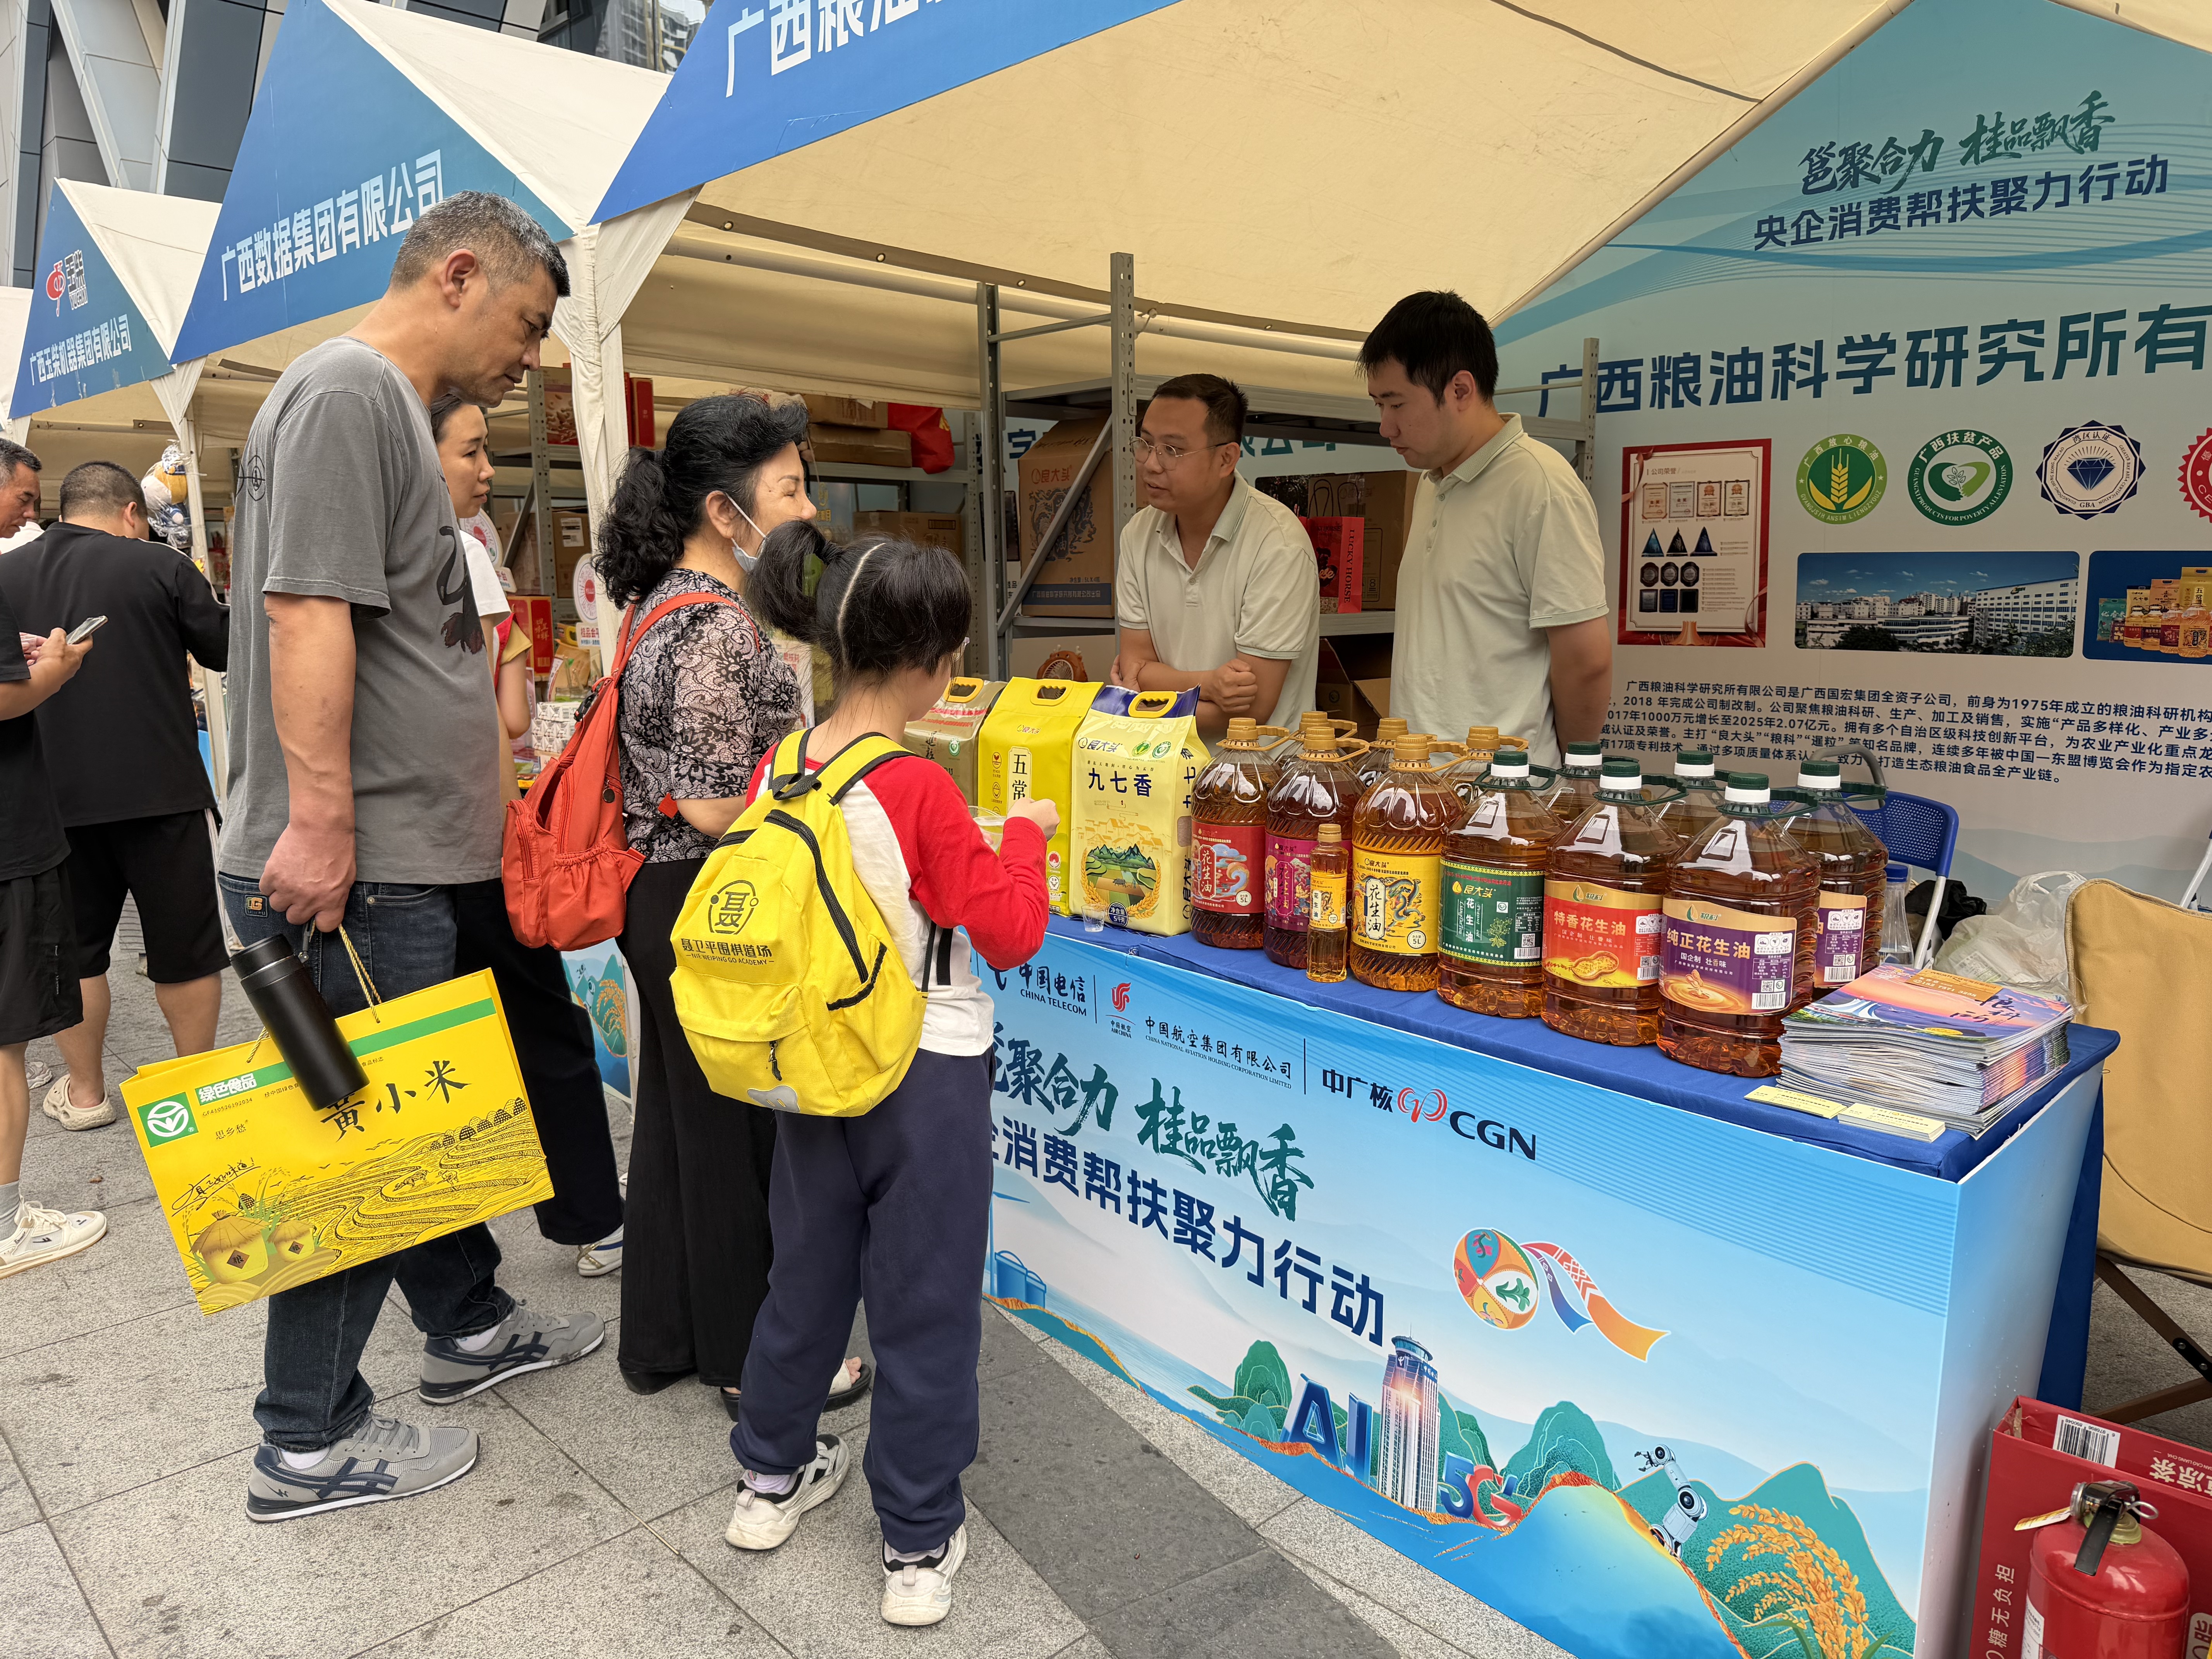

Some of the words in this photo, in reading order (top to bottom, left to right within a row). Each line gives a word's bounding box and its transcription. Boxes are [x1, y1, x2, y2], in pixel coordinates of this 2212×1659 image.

[726, 0, 945, 98] 广西粮
[1959, 89, 2116, 166] 桂品飘香
[1754, 154, 2169, 251] 央企消费帮扶聚力行动
[221, 149, 443, 301] 广西数据集团有限公司
[30, 314, 132, 385] 广西玉柴机器集团有限公司
[1537, 303, 2212, 417] 广西粮油科学研究所有
[1805, 436, 1879, 467] 广西放心粮油
[1918, 431, 2004, 463] 广西扶贫产品
[2072, 431, 2112, 443] 湾区认证
[1041, 467, 1070, 483] 良大头
[1913, 468, 1923, 498] GUANGXI
[1989, 464, 2007, 510] ALLEVIATION
[1917, 496, 1945, 520] PRODUCTS
[1960, 508, 1990, 521] POVERTY
[1346, 529, 1355, 565] LUCKY
[1344, 567, 1352, 603] HORSE
[1087, 740, 1120, 752] 良大头
[1088, 768, 1152, 797] 九七香
[1202, 850, 1212, 893] 花生油
[1464, 885, 1492, 898] 良大头
[1110, 905, 1125, 915] 净含量
[1113, 915, 1126, 924] 5千克
[1368, 884, 1382, 932] 花生油
[1465, 897, 1475, 943] 花生油
[1554, 910, 1626, 936] 特香花生油
[680, 938, 772, 958] 聂卫平围棋道场
[1562, 929, 1582, 938] 国企制
[1589, 935, 1613, 943] 壮香味
[1667, 927, 1751, 960] 纯正花生油
[702, 955, 726, 963] WEIPING
[1680, 952, 1701, 963] 国企制
[1705, 958, 1727, 968] 壮香味
[1019, 962, 1085, 1003] 中国电信
[1020, 989, 1046, 1004] CHINA
[1048, 996, 1087, 1016] TELECOM
[1110, 1019, 1131, 1032] 中国航空
[1118, 1030, 1132, 1039] CHINA
[1145, 1016, 1291, 1080] 中国航空集团有限公司
[1146, 1035, 1160, 1044] CHINA
[1161, 1040, 1184, 1052] NATIONAL
[1185, 1048, 1207, 1060] AVIATION
[1208, 1056, 1231, 1068] HOLDING
[1231, 1063, 1269, 1081] CORPORATION
[1269, 1077, 1292, 1089] LIMITED
[198, 1073, 257, 1104] 绿色食品
[320, 1060, 472, 1142] 黄小米
[1322, 1069, 1393, 1113] 中广核
[215, 1124, 247, 1141] 思乡愁
[1449, 1110, 1536, 1161] CGN
[1135, 1078, 1314, 1222] 桂品飘香
[1279, 1373, 1372, 1486] AI
[2065, 1418, 2083, 1427] 890046
[2178, 1457, 2193, 1465] LIANG
[1438, 1451, 1523, 1527] 5G
